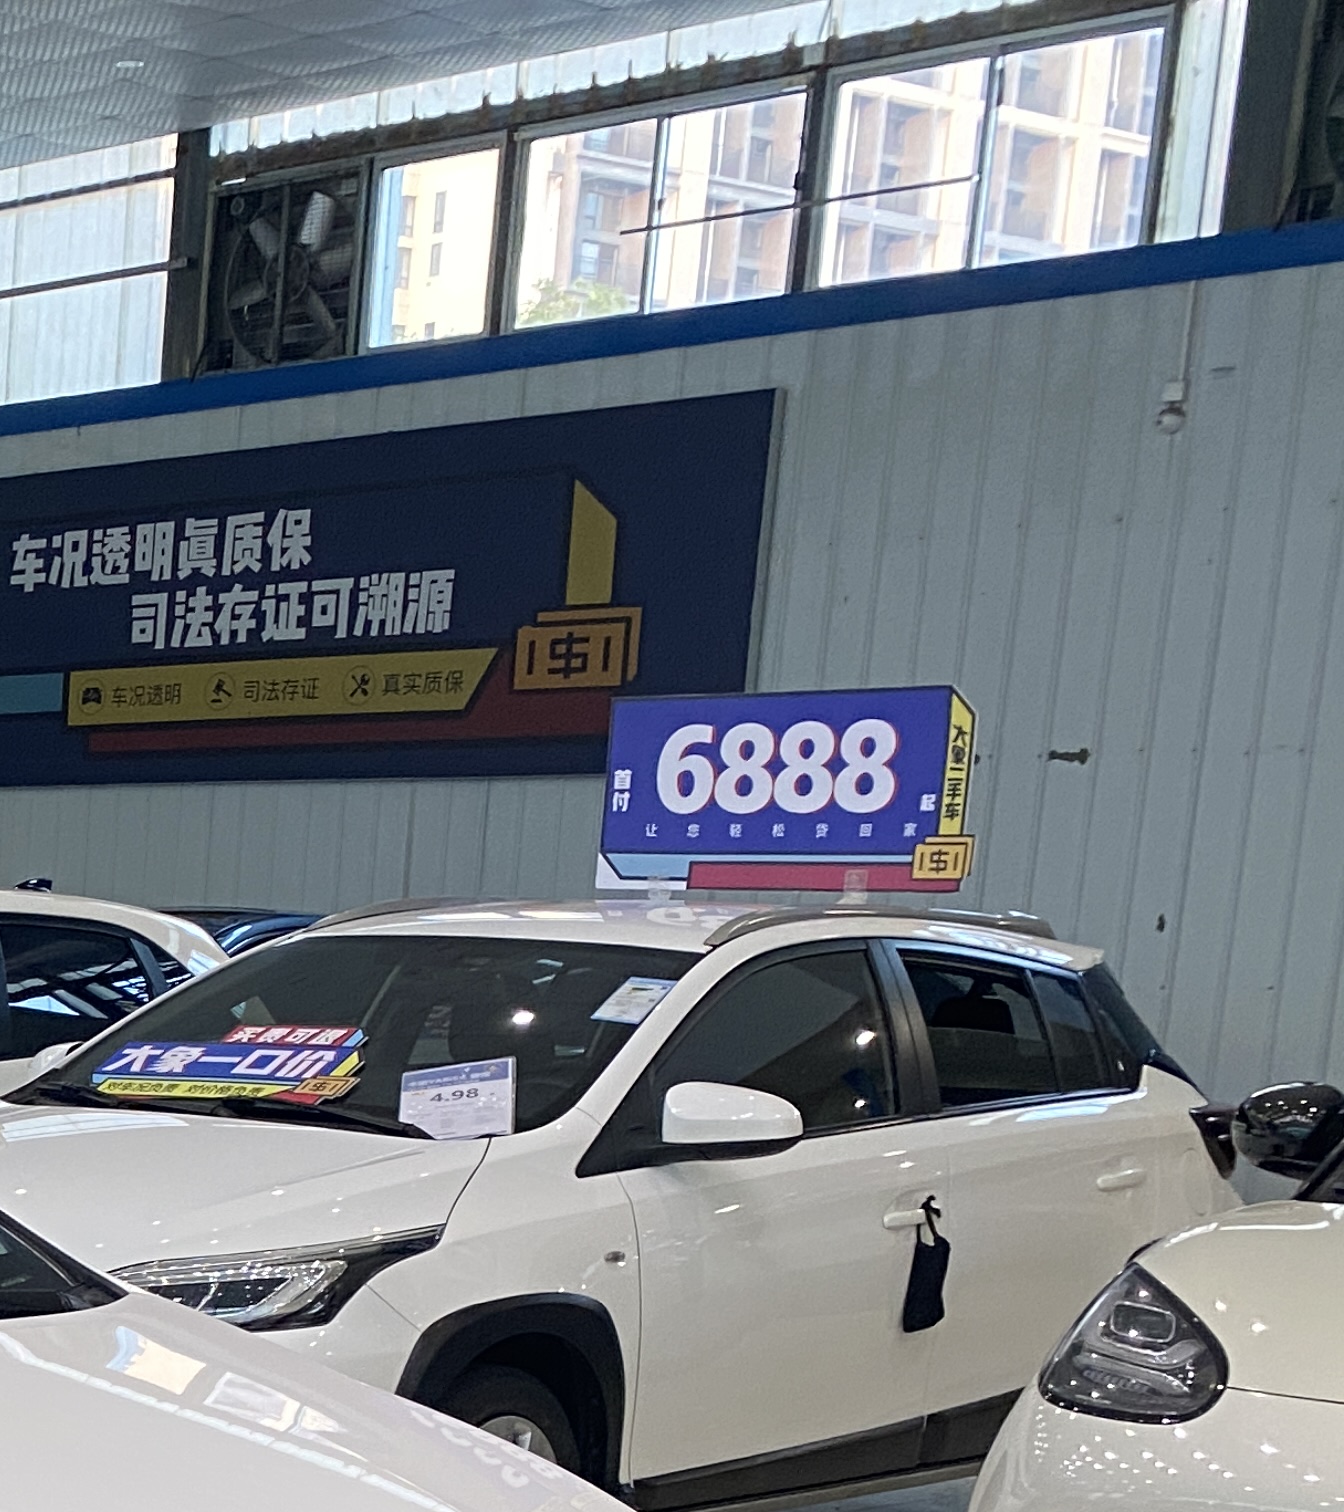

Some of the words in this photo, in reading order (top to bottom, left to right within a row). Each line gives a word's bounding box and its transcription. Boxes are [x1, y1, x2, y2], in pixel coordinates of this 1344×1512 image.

[130, 569, 456, 650] 司法存证可溯源
[112, 683, 182, 709] 车况透明
[243, 677, 320, 703] 司法存证
[382, 671, 465, 697] 真实质保
[656, 717, 899, 815] 6888
[612, 769, 632, 813] 首付
[102, 1045, 337, 1078] 大象一口价
[429, 1087, 480, 1102] 4.98
